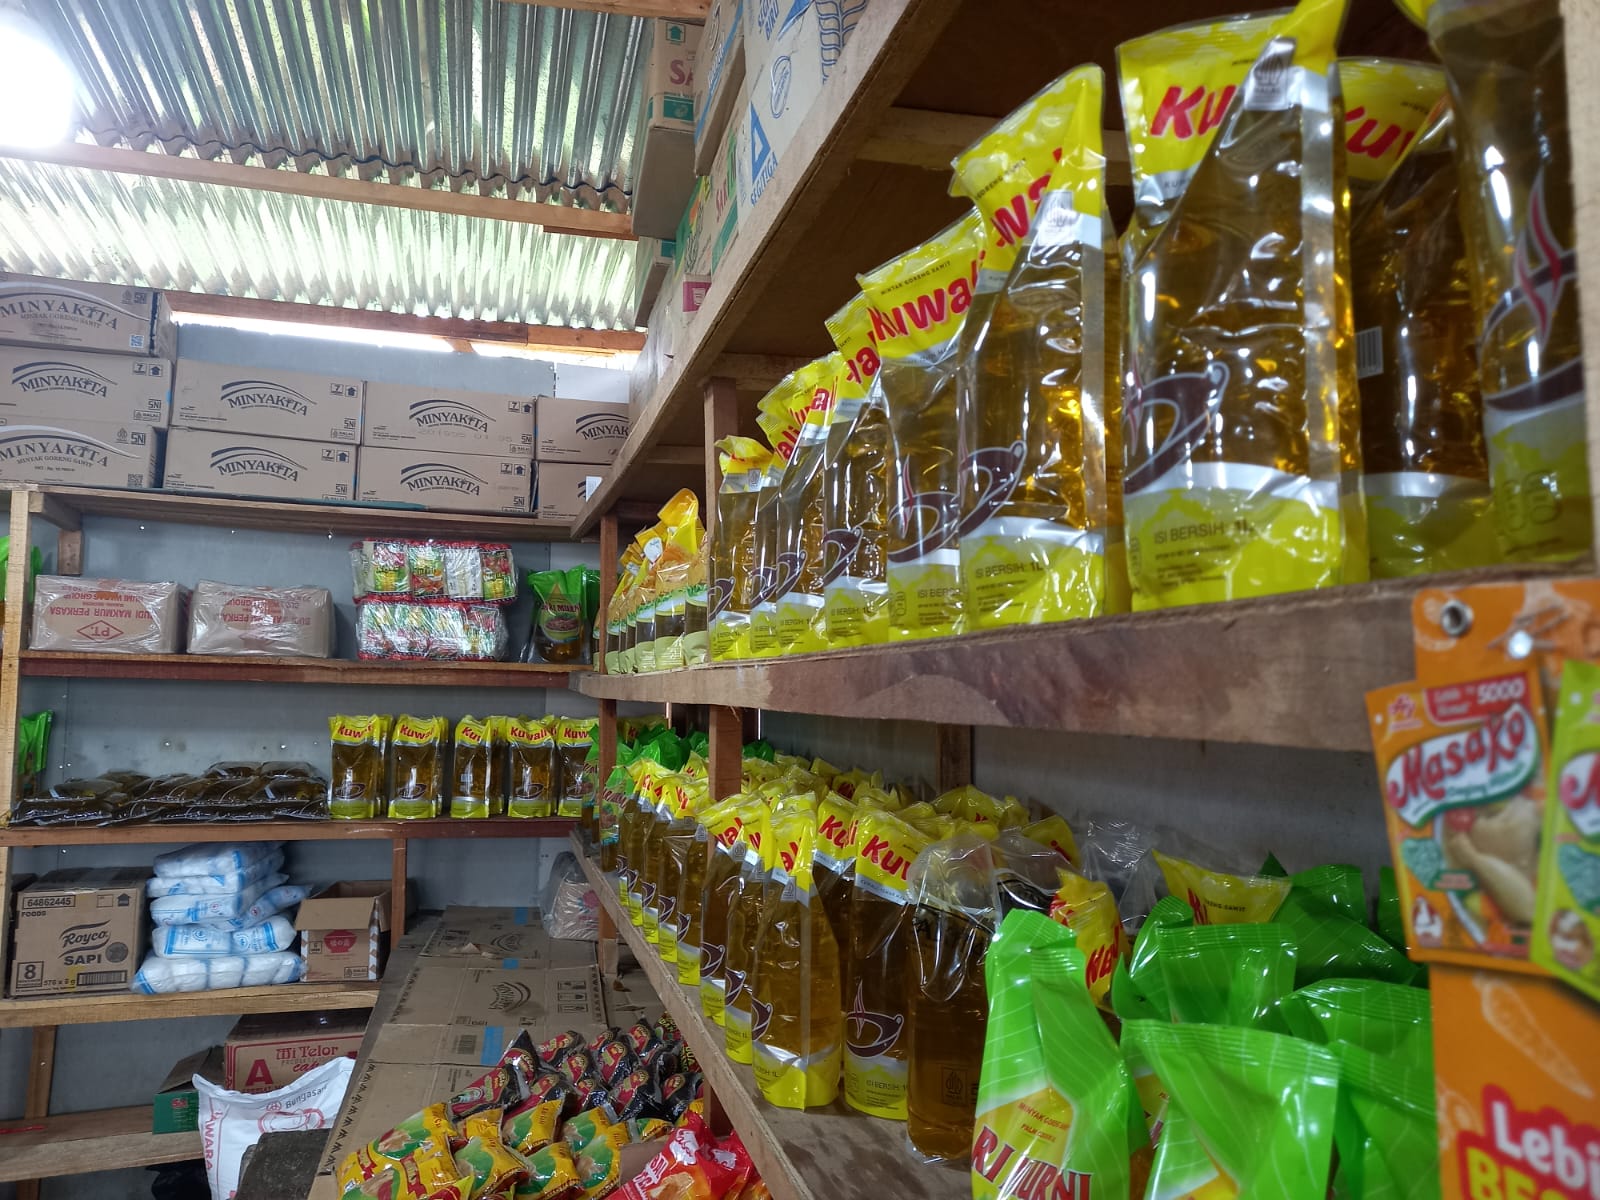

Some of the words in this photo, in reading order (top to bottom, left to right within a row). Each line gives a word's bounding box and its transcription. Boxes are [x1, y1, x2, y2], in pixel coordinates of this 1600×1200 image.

[750, 151, 779, 207] SEGITIGA
[0, 299, 118, 330] MINYAKITA
[19, 375, 108, 398] MINYAKITA
[148, 399, 161, 410] SNI
[227, 393, 308, 416] MINYAKITA
[344, 418, 356, 429] SNI
[416, 412, 488, 433] MINYAKITA
[131, 432, 146, 445] SNI
[521, 434, 533, 444] SNI
[581, 424, 629, 440] MINYAK
[0, 442, 109, 468] MINYAKITA
[218, 460, 299, 482] MINYAKITA
[335, 483, 348, 494] SNI
[407, 475, 480, 496] MINYAKITA
[513, 496, 525, 506] SNI
[1170, 521, 1225, 542] BERSIH
[985, 561, 1025, 577] BERSIH
[50, 606, 91, 616] PERKASA
[93, 607, 132, 618] MAKMUR
[1477, 677, 1525, 705] 5000
[21, 910, 46, 918] FOODS
[62, 930, 109, 949] Royco
[64, 954, 102, 965] SAPI
[24, 964, 36, 980] 8
[300, 1045, 339, 1058] Telor
[245, 1058, 273, 1087] A
